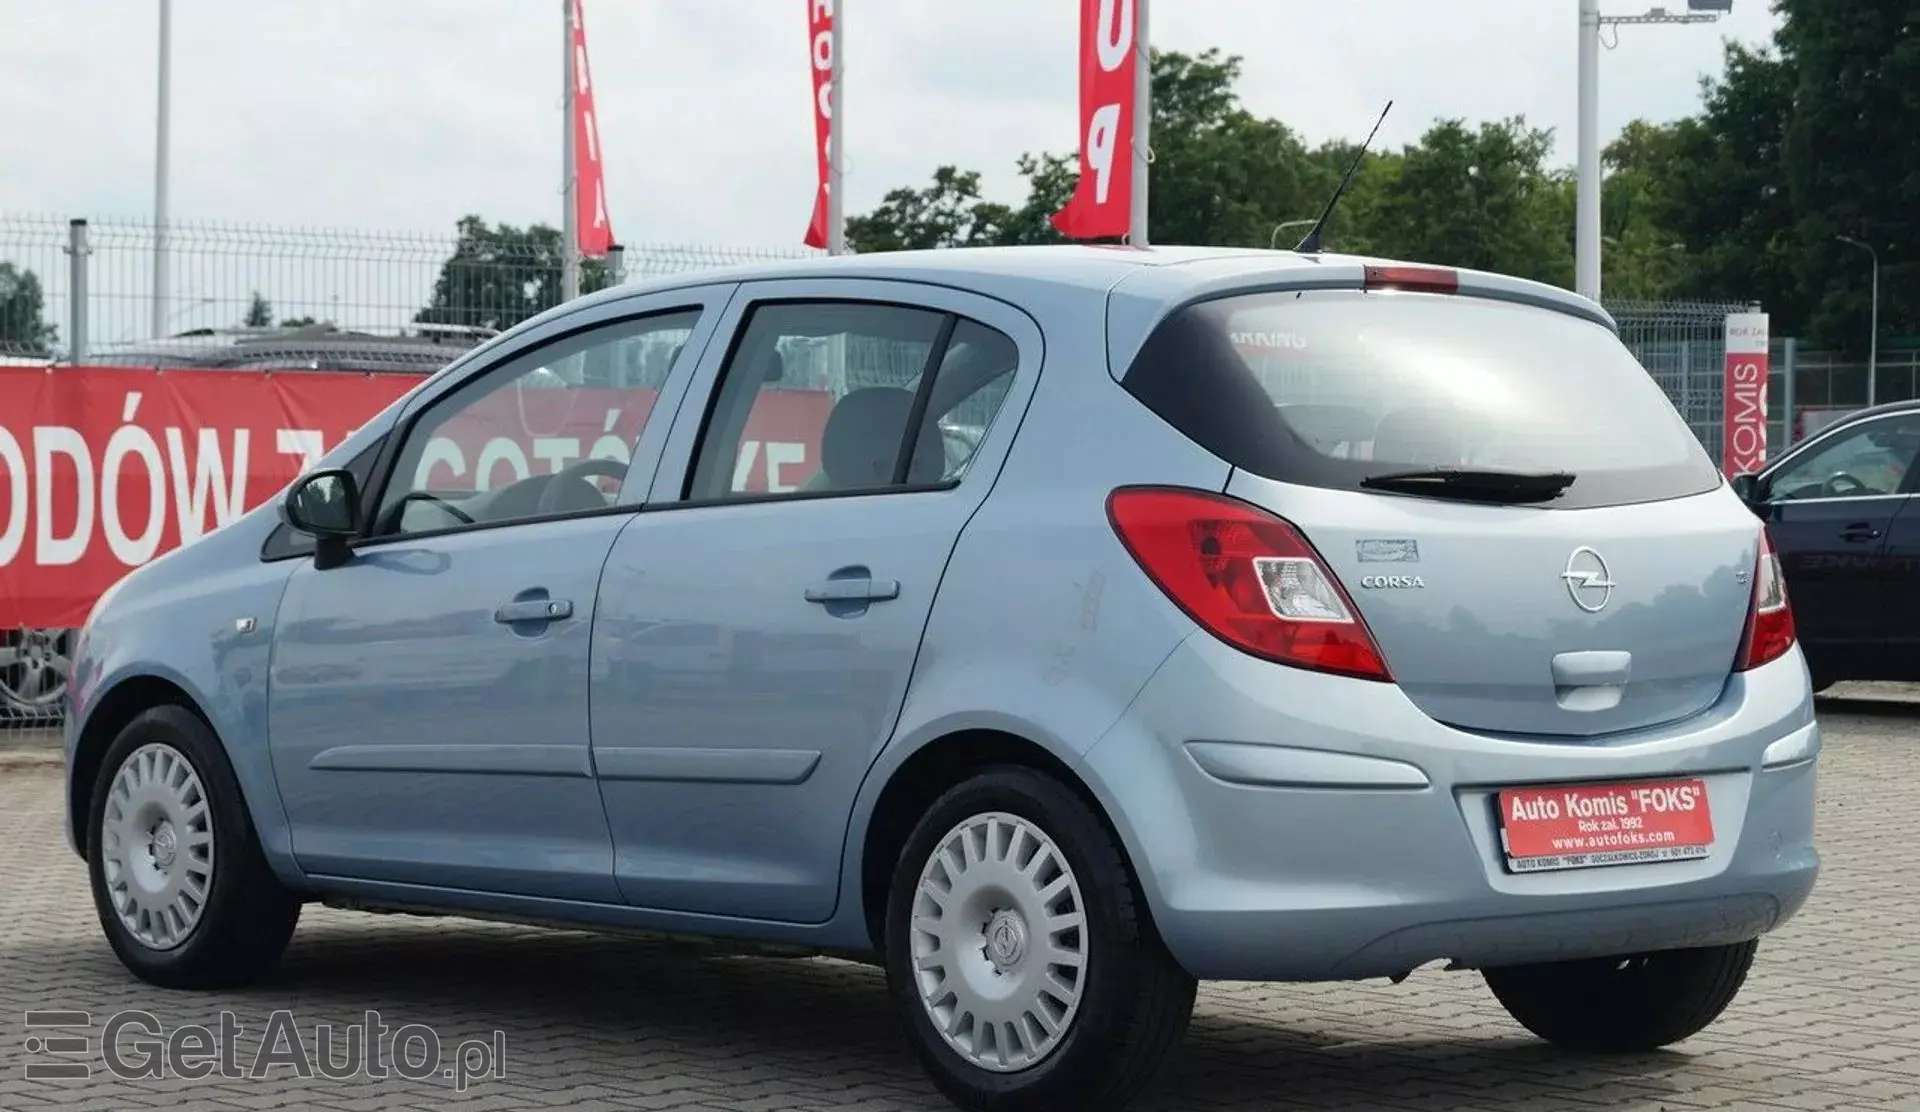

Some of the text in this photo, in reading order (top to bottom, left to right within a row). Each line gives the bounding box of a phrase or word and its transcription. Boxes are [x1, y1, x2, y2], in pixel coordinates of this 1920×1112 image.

[1733, 362, 1757, 477] KOMIS
[1360, 575, 1425, 589] CORSA
[1511, 785, 1700, 821] Auto Komis "FOKS"
[1578, 819, 1600, 832] Rok
[1620, 816, 1644, 829] 1992
[1552, 831, 1675, 850] www.autofoks.com
[1516, 858, 1537, 869] AUTO
